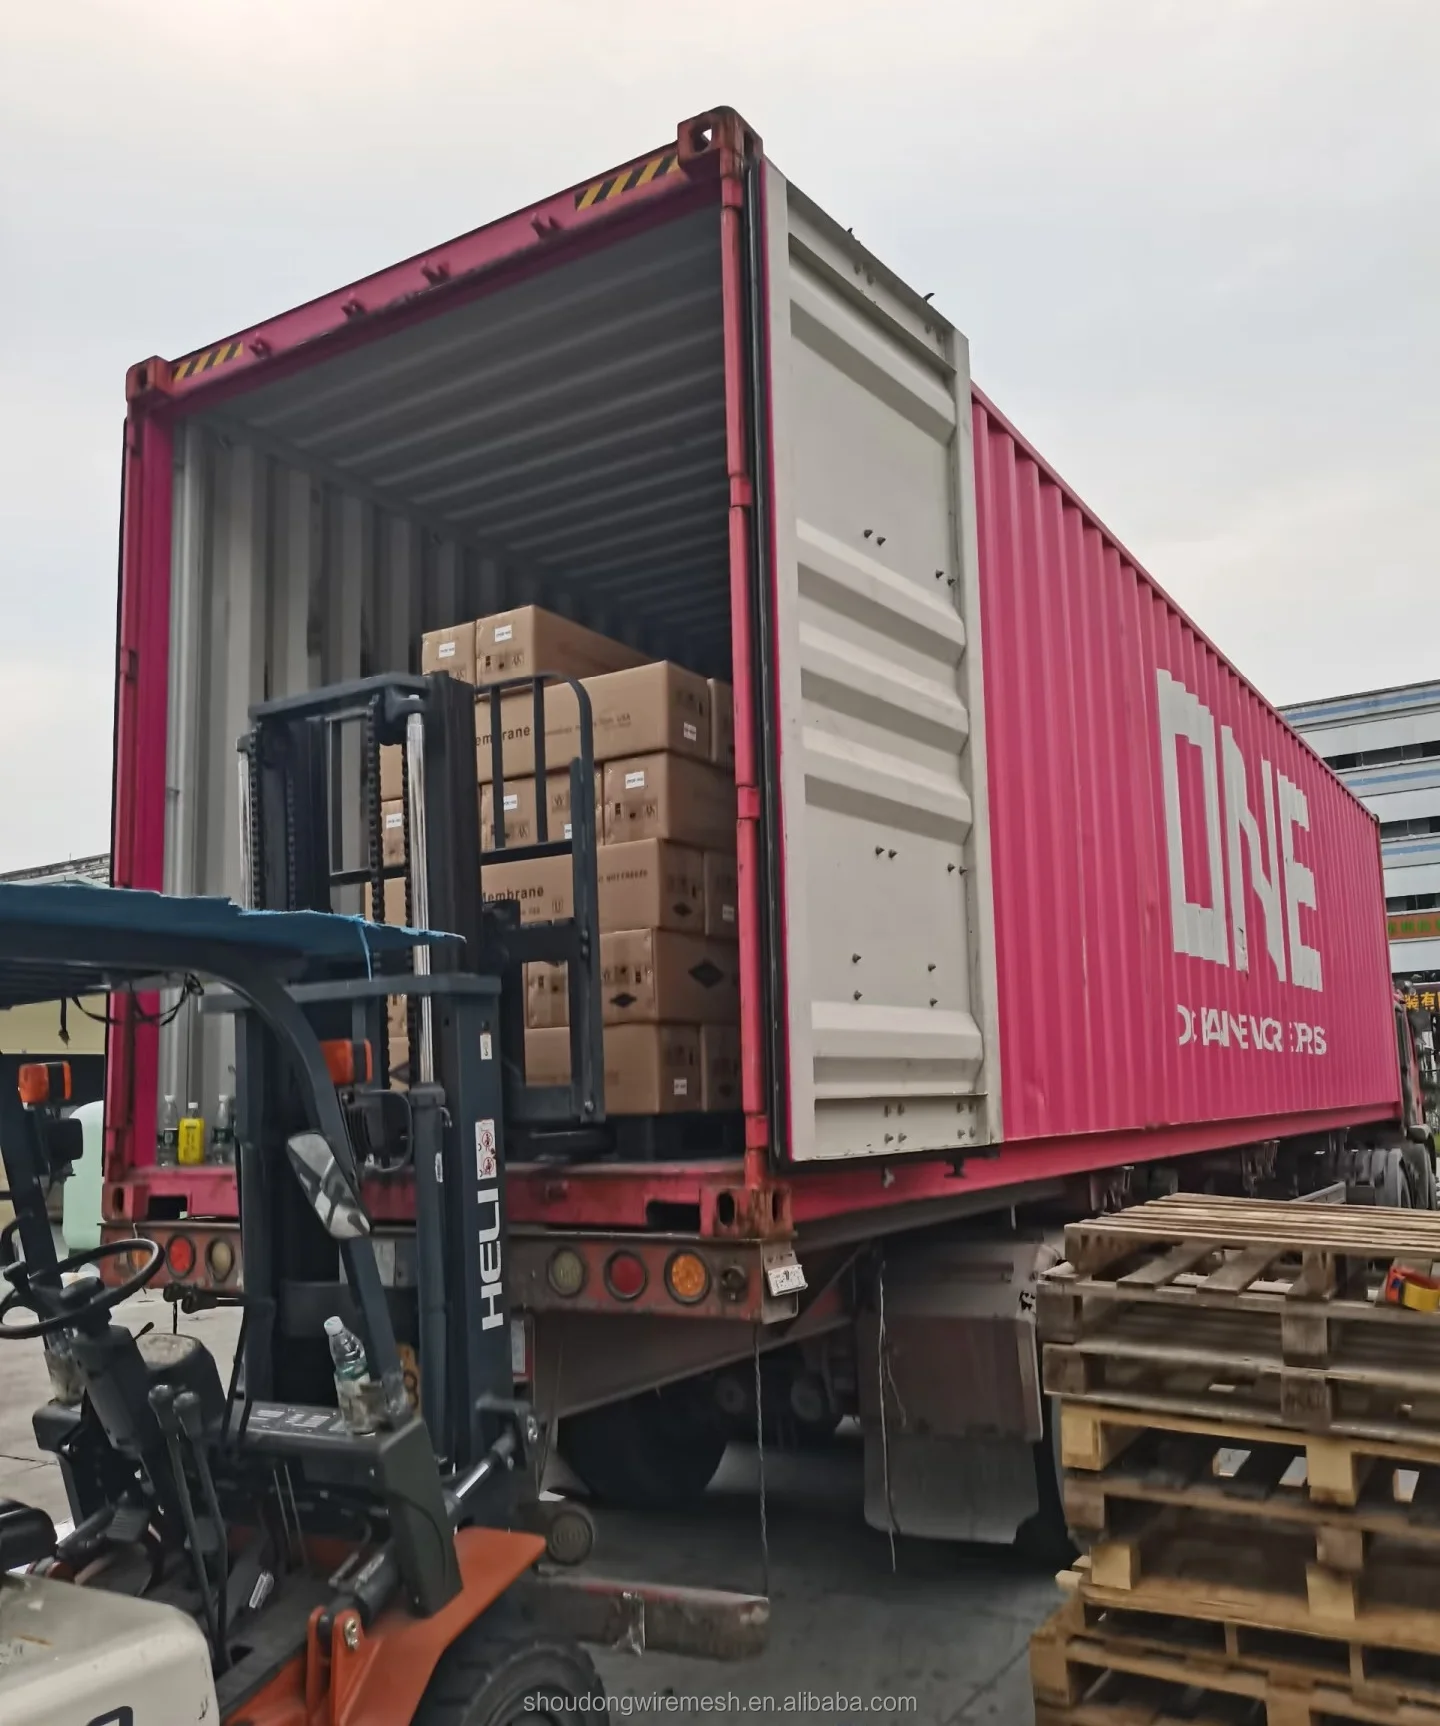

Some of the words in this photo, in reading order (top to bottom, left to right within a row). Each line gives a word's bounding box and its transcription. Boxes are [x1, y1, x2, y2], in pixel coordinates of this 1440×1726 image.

[475, 726, 531, 746] emrane
[1156, 668, 1323, 993] ONE
[477, 1187, 504, 1331] HELI
